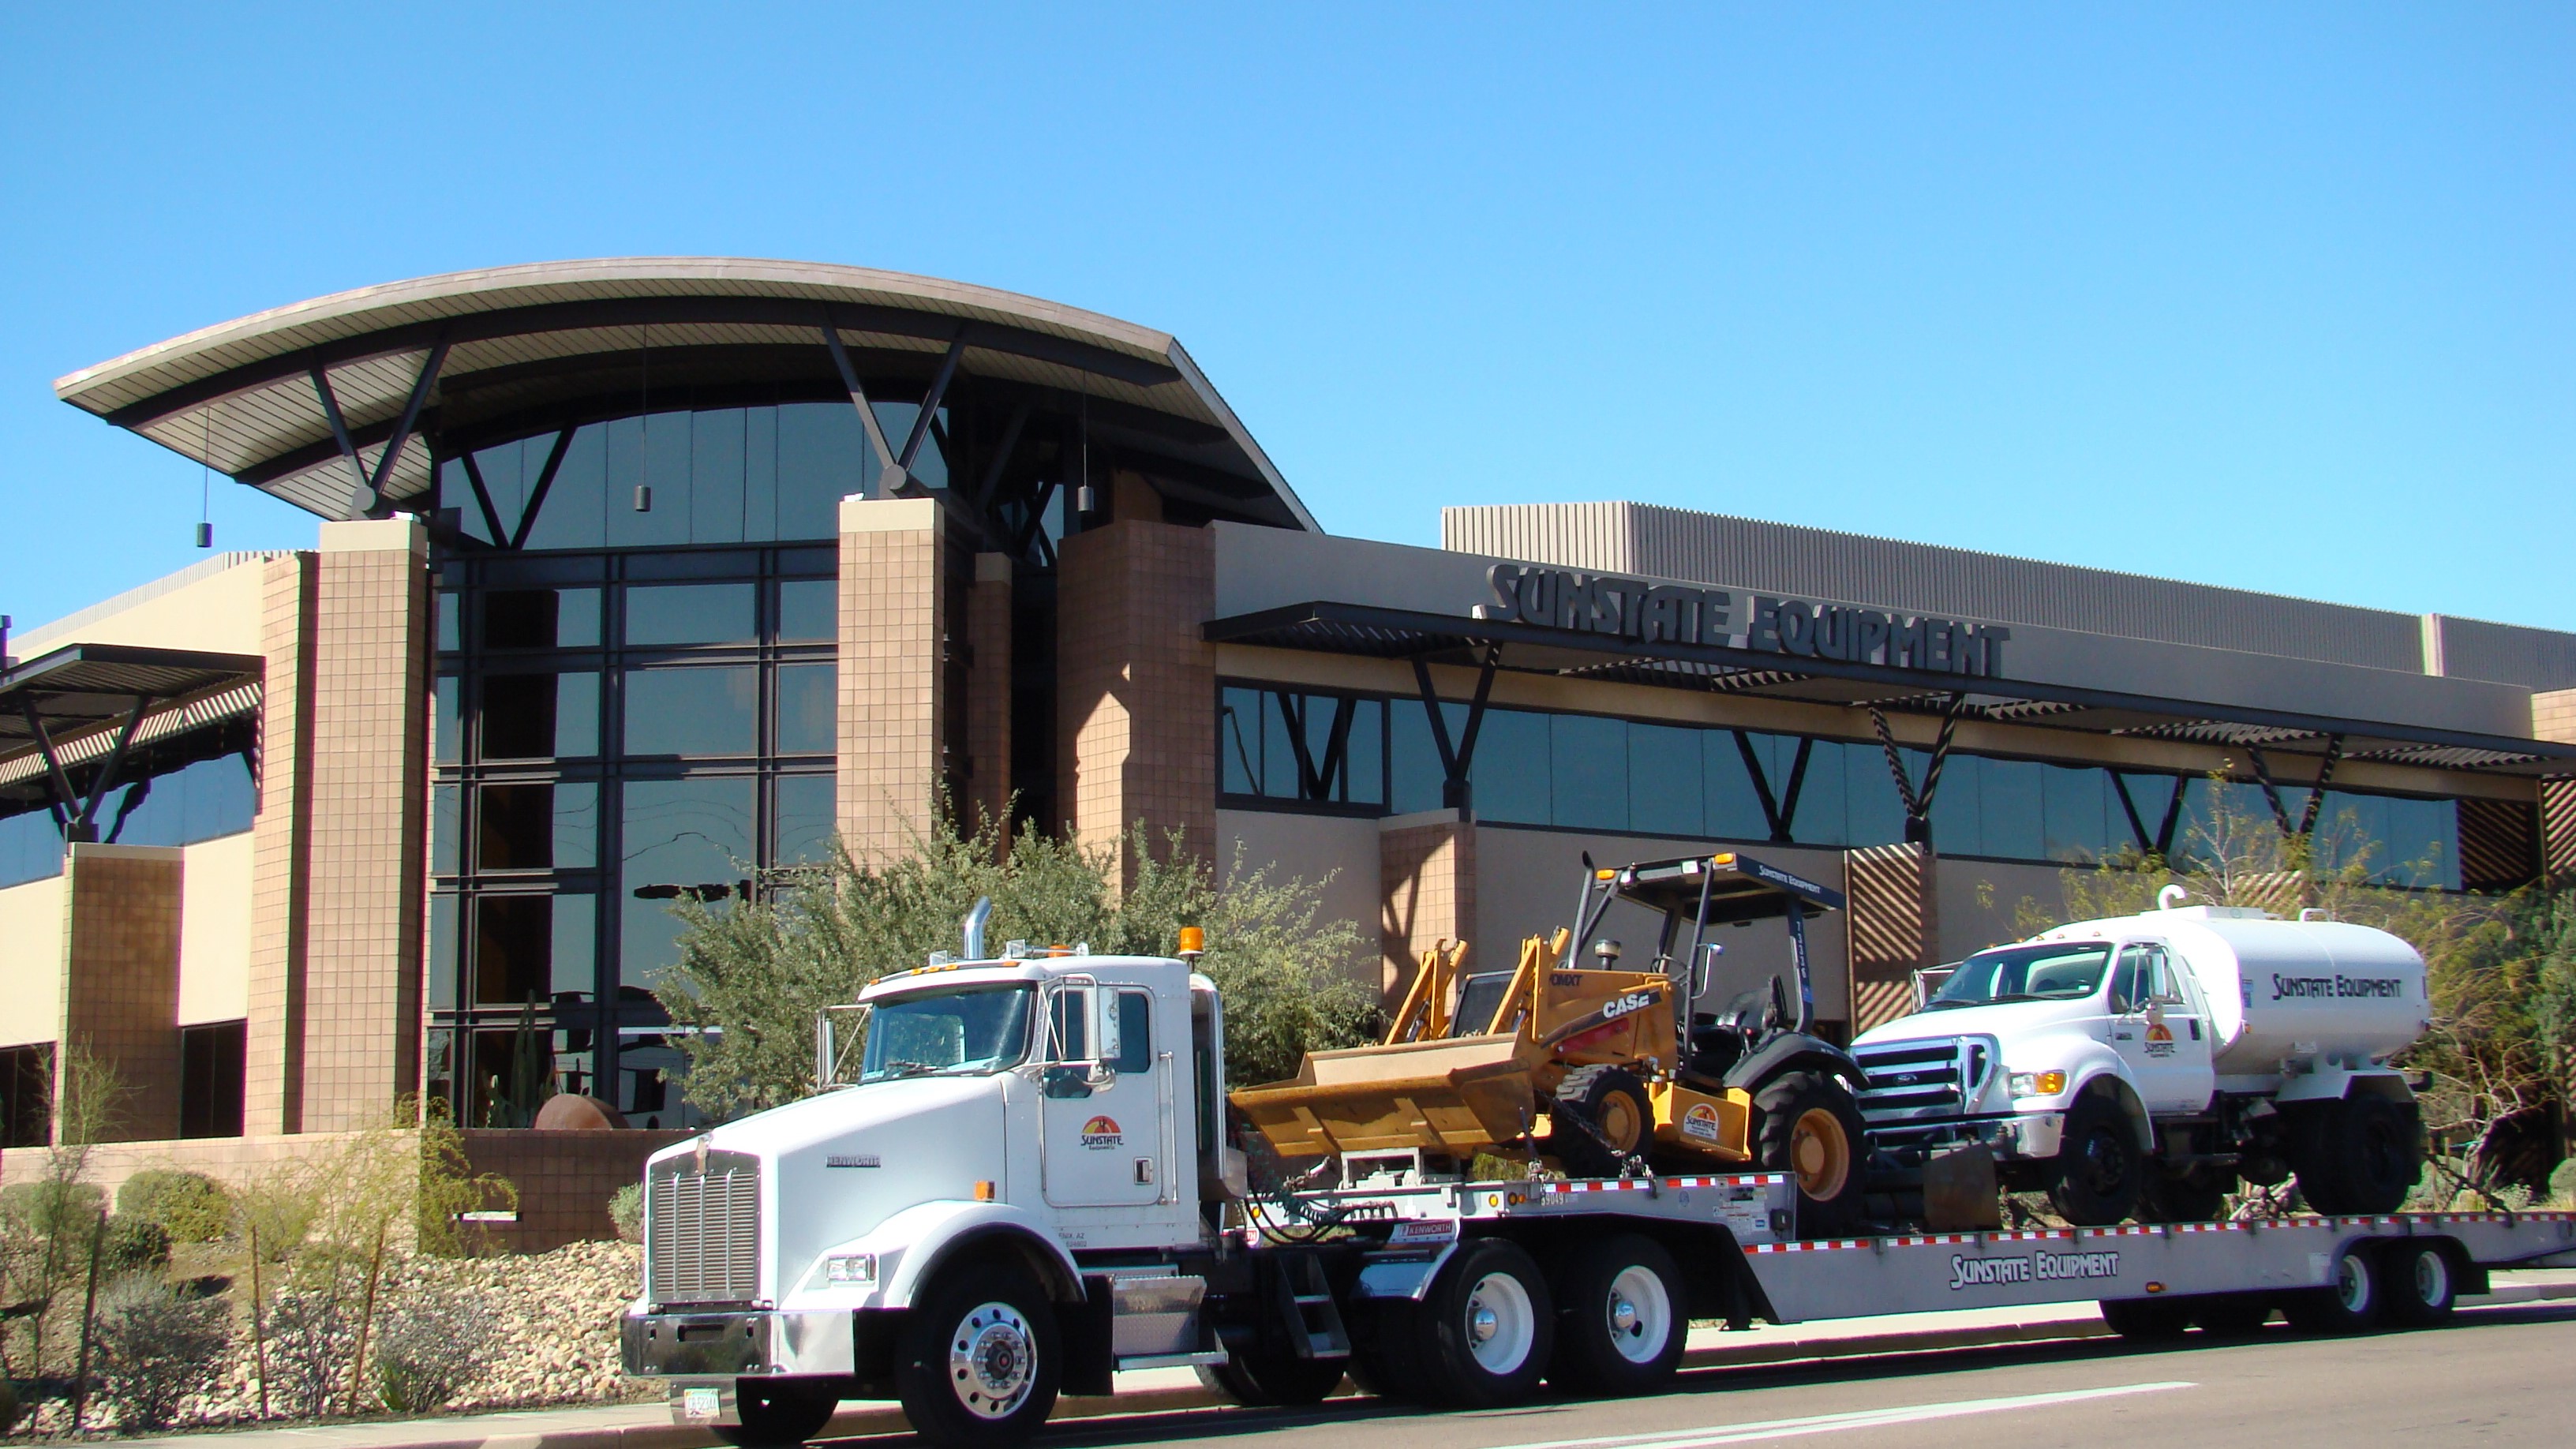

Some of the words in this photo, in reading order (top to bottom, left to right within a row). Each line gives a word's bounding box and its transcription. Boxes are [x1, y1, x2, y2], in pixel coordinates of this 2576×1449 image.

[1472, 564, 1732, 648] SUNSTATE
[1747, 596, 2011, 679] EQUIPMENT
[1758, 864, 1788, 884] SUNSTATE
[1788, 874, 1822, 894] EQUIPMENT
[2271, 972, 2334, 1001] SUNSTATE
[2335, 974, 2402, 998] EQUIPMENT
[1603, 993, 1649, 1019] CASE
[1080, 1134, 1125, 1147] SUNSTATE
[1408, 1222, 1452, 1235] KENWORTH
[1949, 1253, 2031, 1290] SUNSTATE
[2035, 1250, 2120, 1280] EQUIPMENT
